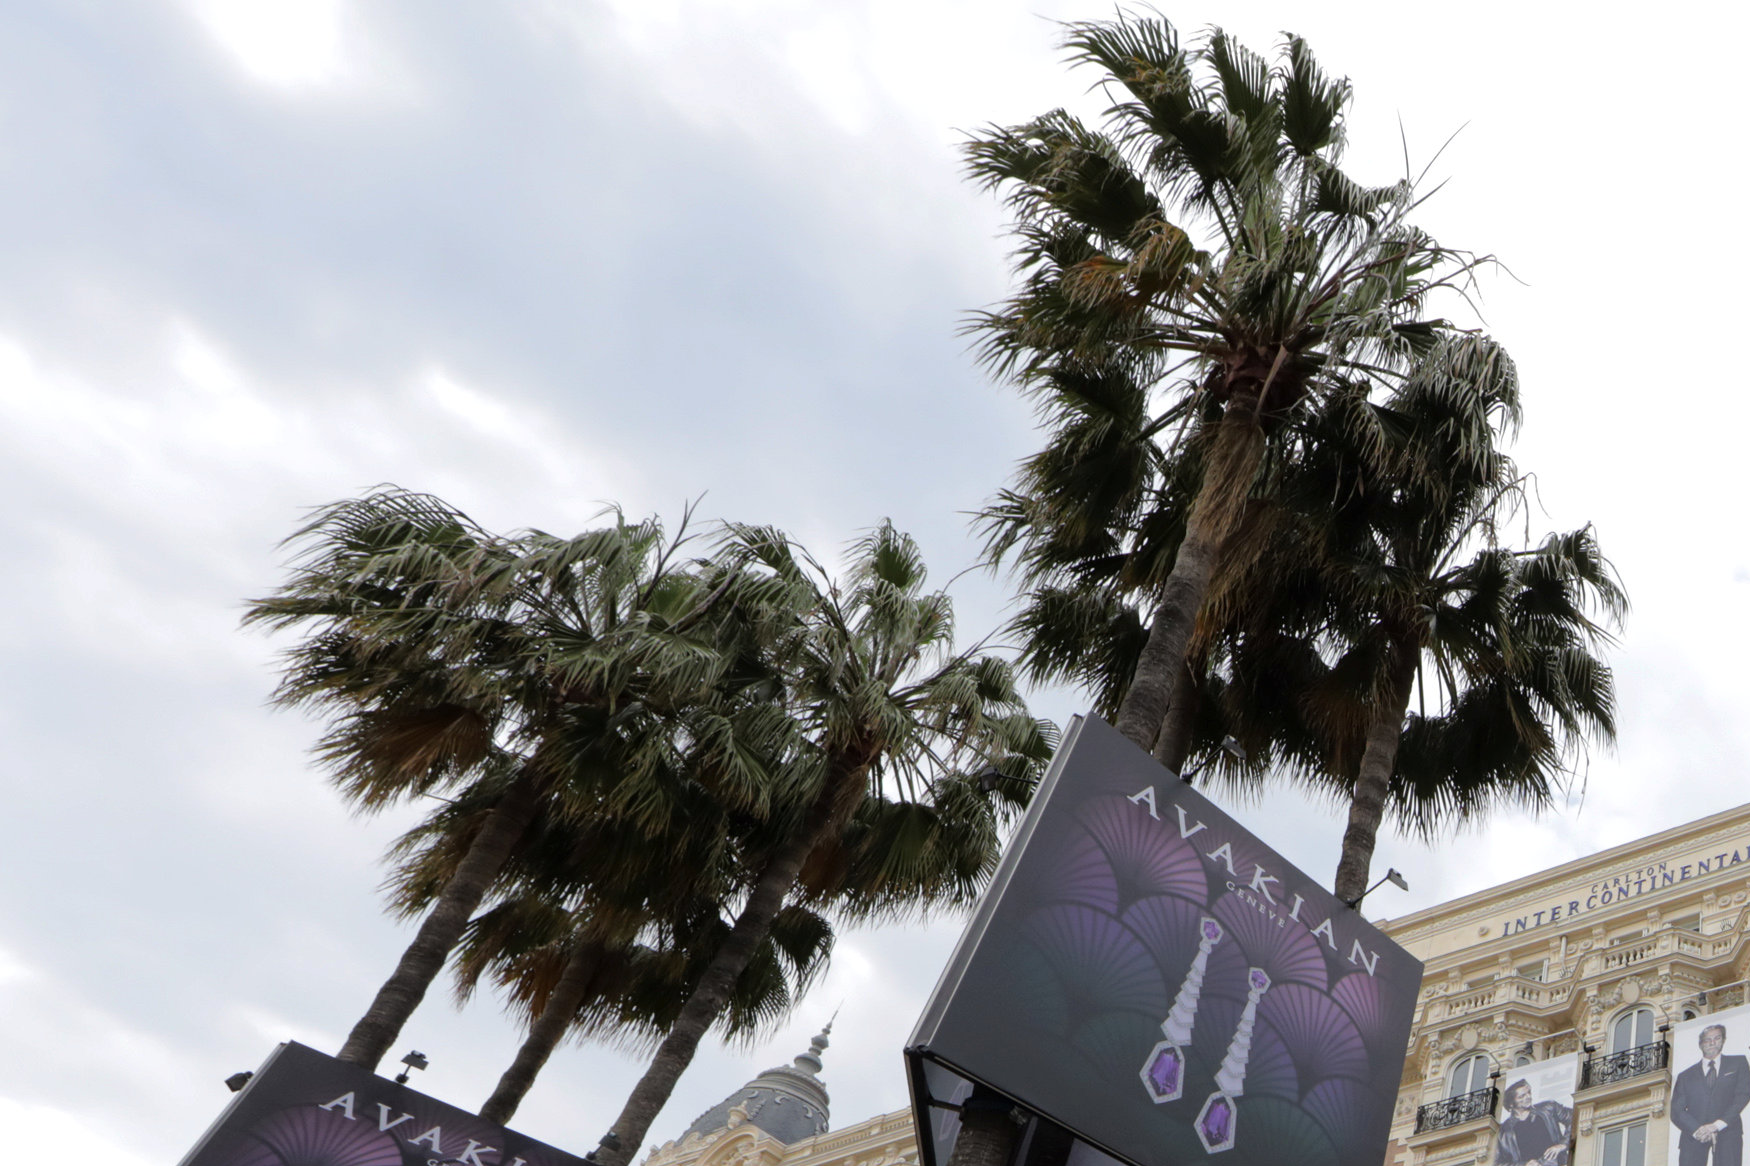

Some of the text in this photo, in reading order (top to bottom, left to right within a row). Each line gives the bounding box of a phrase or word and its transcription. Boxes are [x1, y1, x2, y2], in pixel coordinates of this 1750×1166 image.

[1127, 785, 1380, 977] AVAKIAN
[1591, 862, 1668, 894] CARLTON
[1226, 881, 1287, 928] GENEVE
